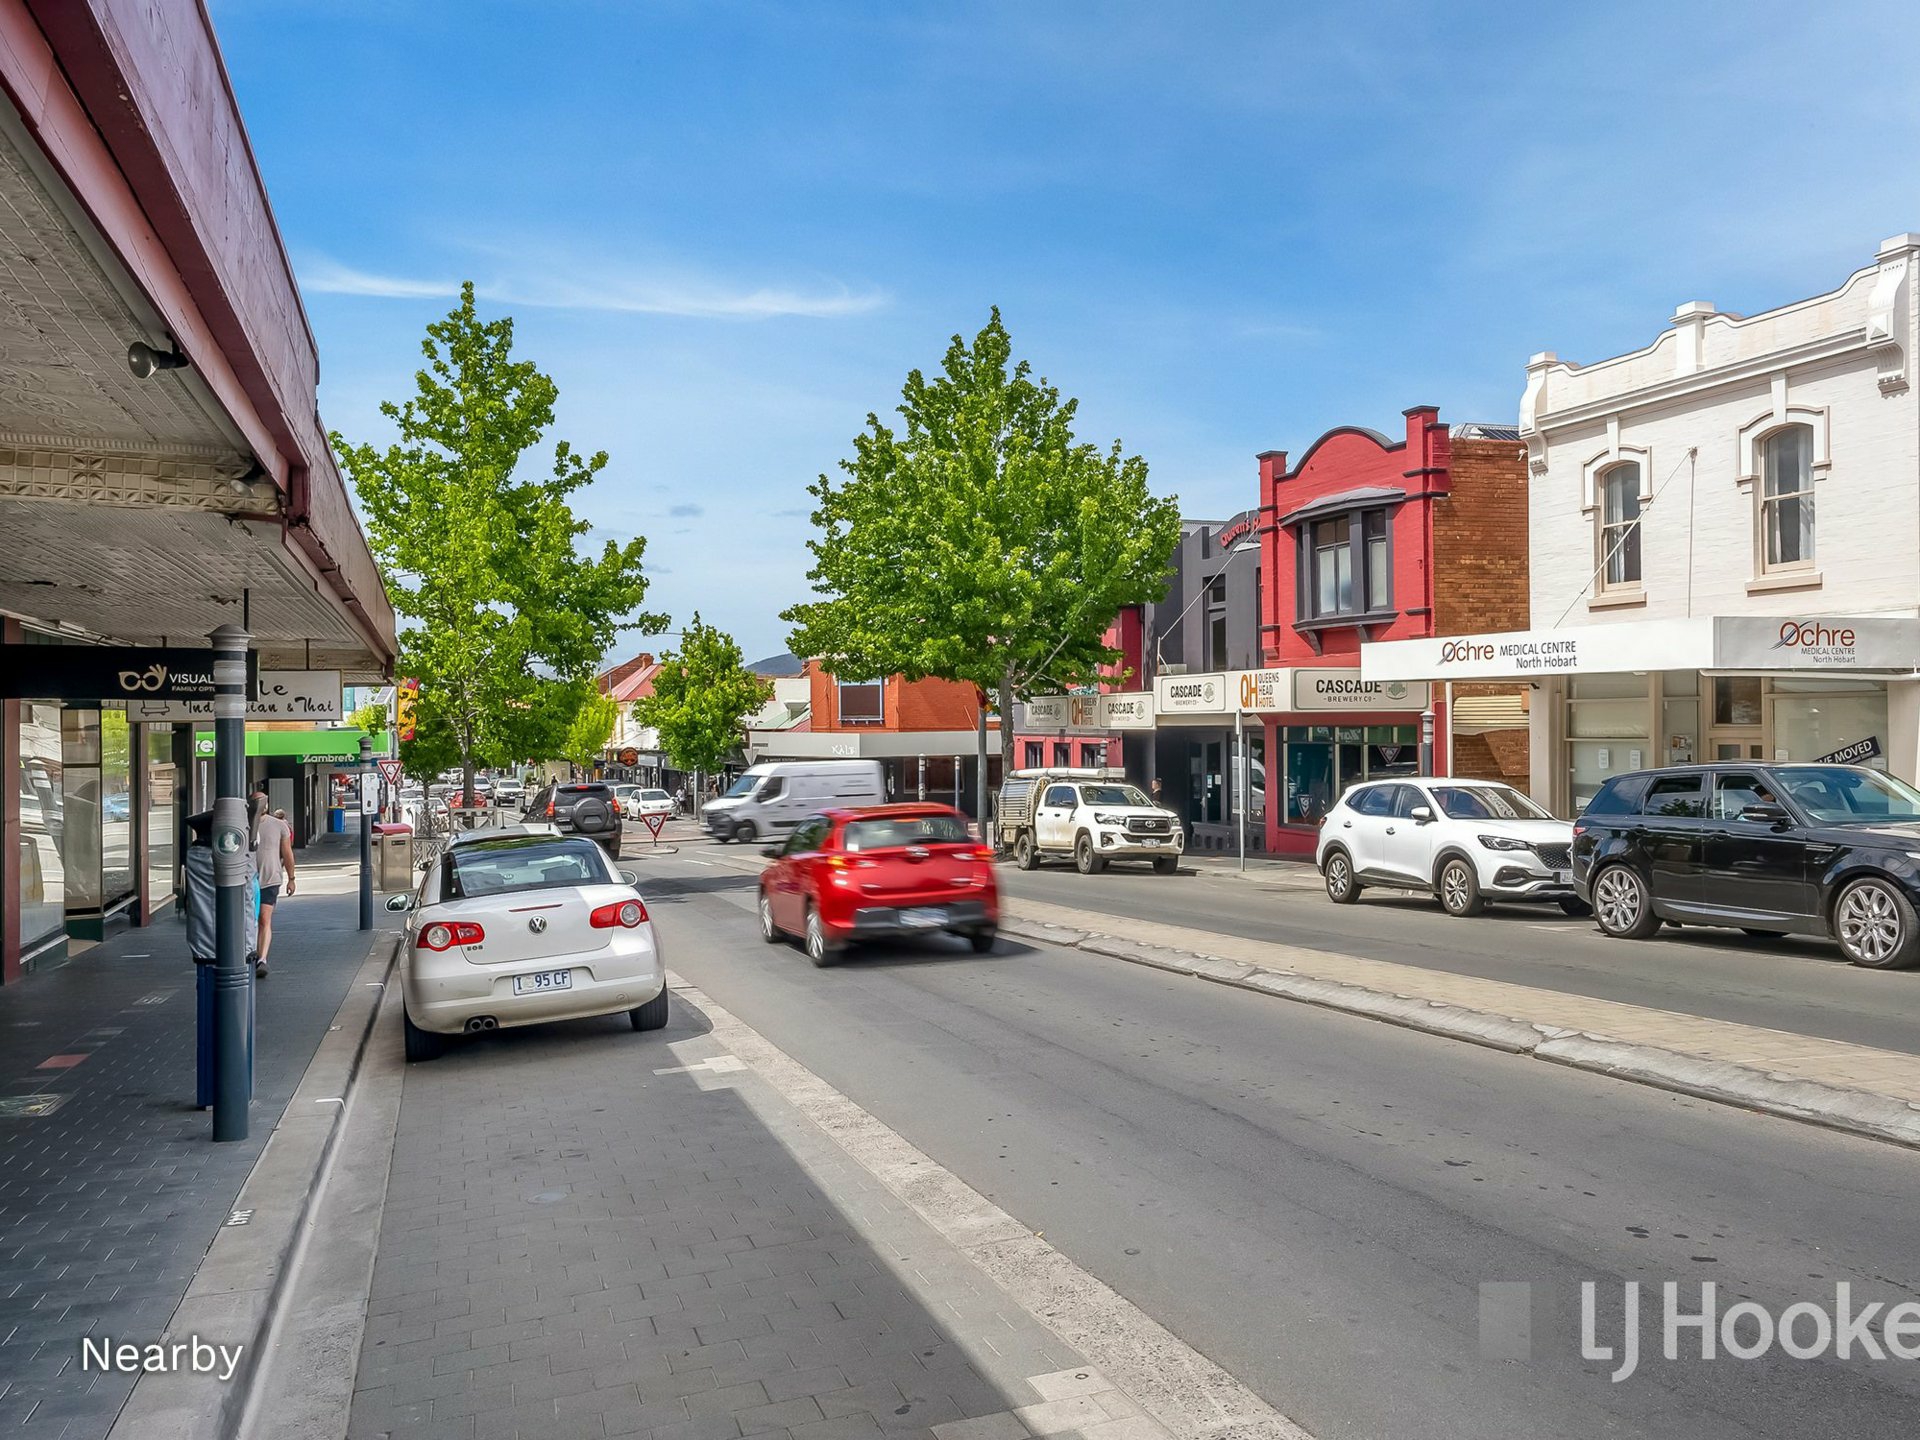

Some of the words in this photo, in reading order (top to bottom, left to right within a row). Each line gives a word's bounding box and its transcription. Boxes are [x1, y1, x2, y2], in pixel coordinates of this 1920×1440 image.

[1780, 621, 1855, 647] Ochre
[1442, 641, 1494, 662] Ochre
[1500, 643, 1539, 656] MEDICAL
[1541, 641, 1576, 655] CENTRE
[1516, 657, 1542, 669] North
[1544, 655, 1577, 667] Hobart
[169, 673, 215, 684] VISUAL
[1258, 672, 1280, 684] QUEENS
[1170, 684, 1202, 698] CASCADE
[1240, 673, 1258, 708] QH
[1259, 684, 1274, 696] HEAD
[1316, 679, 1382, 693] CASCADE
[286, 703, 294, 712] &
[294, 696, 334, 713] Thai
[1031, 704, 1053, 715] CASCADE
[1108, 703, 1134, 714] CASCADE
[1259, 697, 1276, 708] HOTEL
[303, 753, 355, 763] Zambrero
[1834, 740, 1872, 763] MOVED
[534, 974, 551, 988] 95
[553, 971, 568, 985] CF
